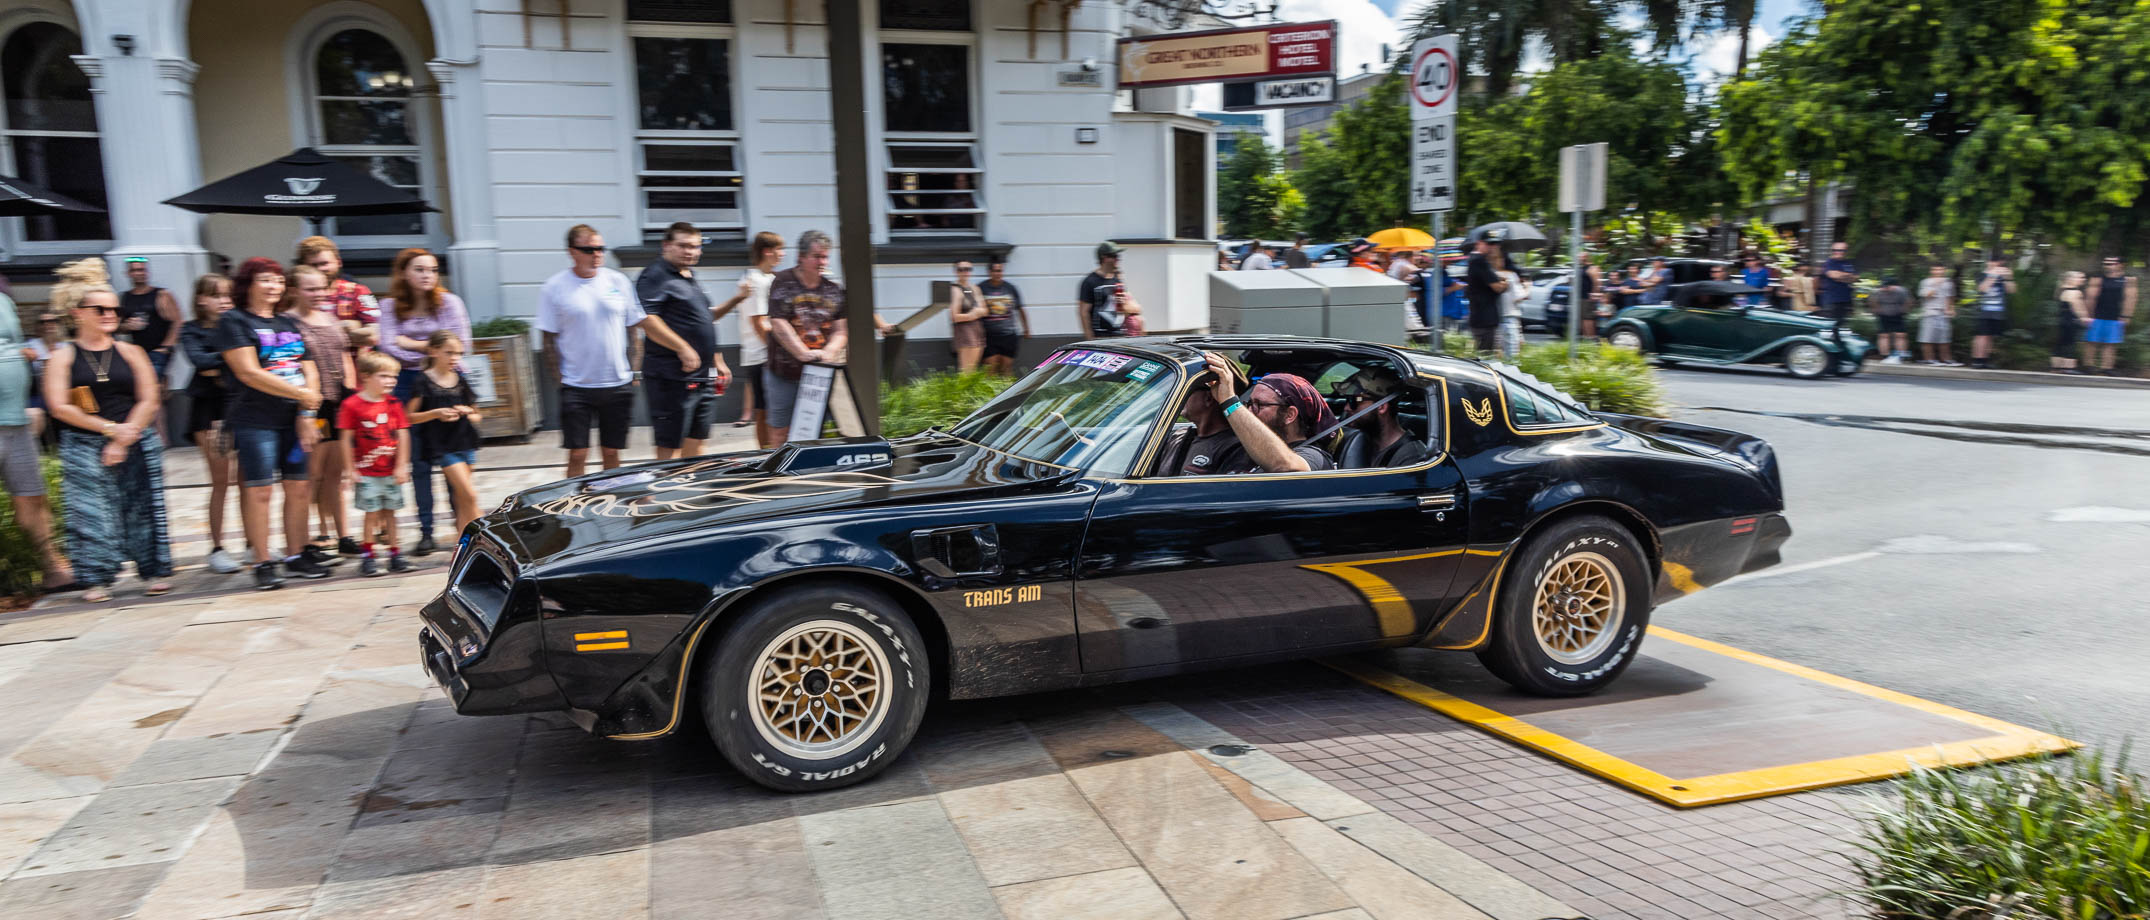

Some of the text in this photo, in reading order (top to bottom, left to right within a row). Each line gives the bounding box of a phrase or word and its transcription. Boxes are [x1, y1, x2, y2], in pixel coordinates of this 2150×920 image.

[1146, 43, 1263, 64] GREAT NORTHERN
[1278, 43, 1320, 54] HOTEL
[1277, 55, 1320, 67] MOTEL
[1417, 62, 1449, 92] 40
[1265, 82, 1325, 99] VACANCY
[1418, 124, 1448, 143] END
[1534, 537, 1606, 588] GALAXY
[963, 584, 1041, 607] TRANS AM
[830, 602, 912, 668] GALAXY
[750, 742, 887, 781] RADIAL G/T
